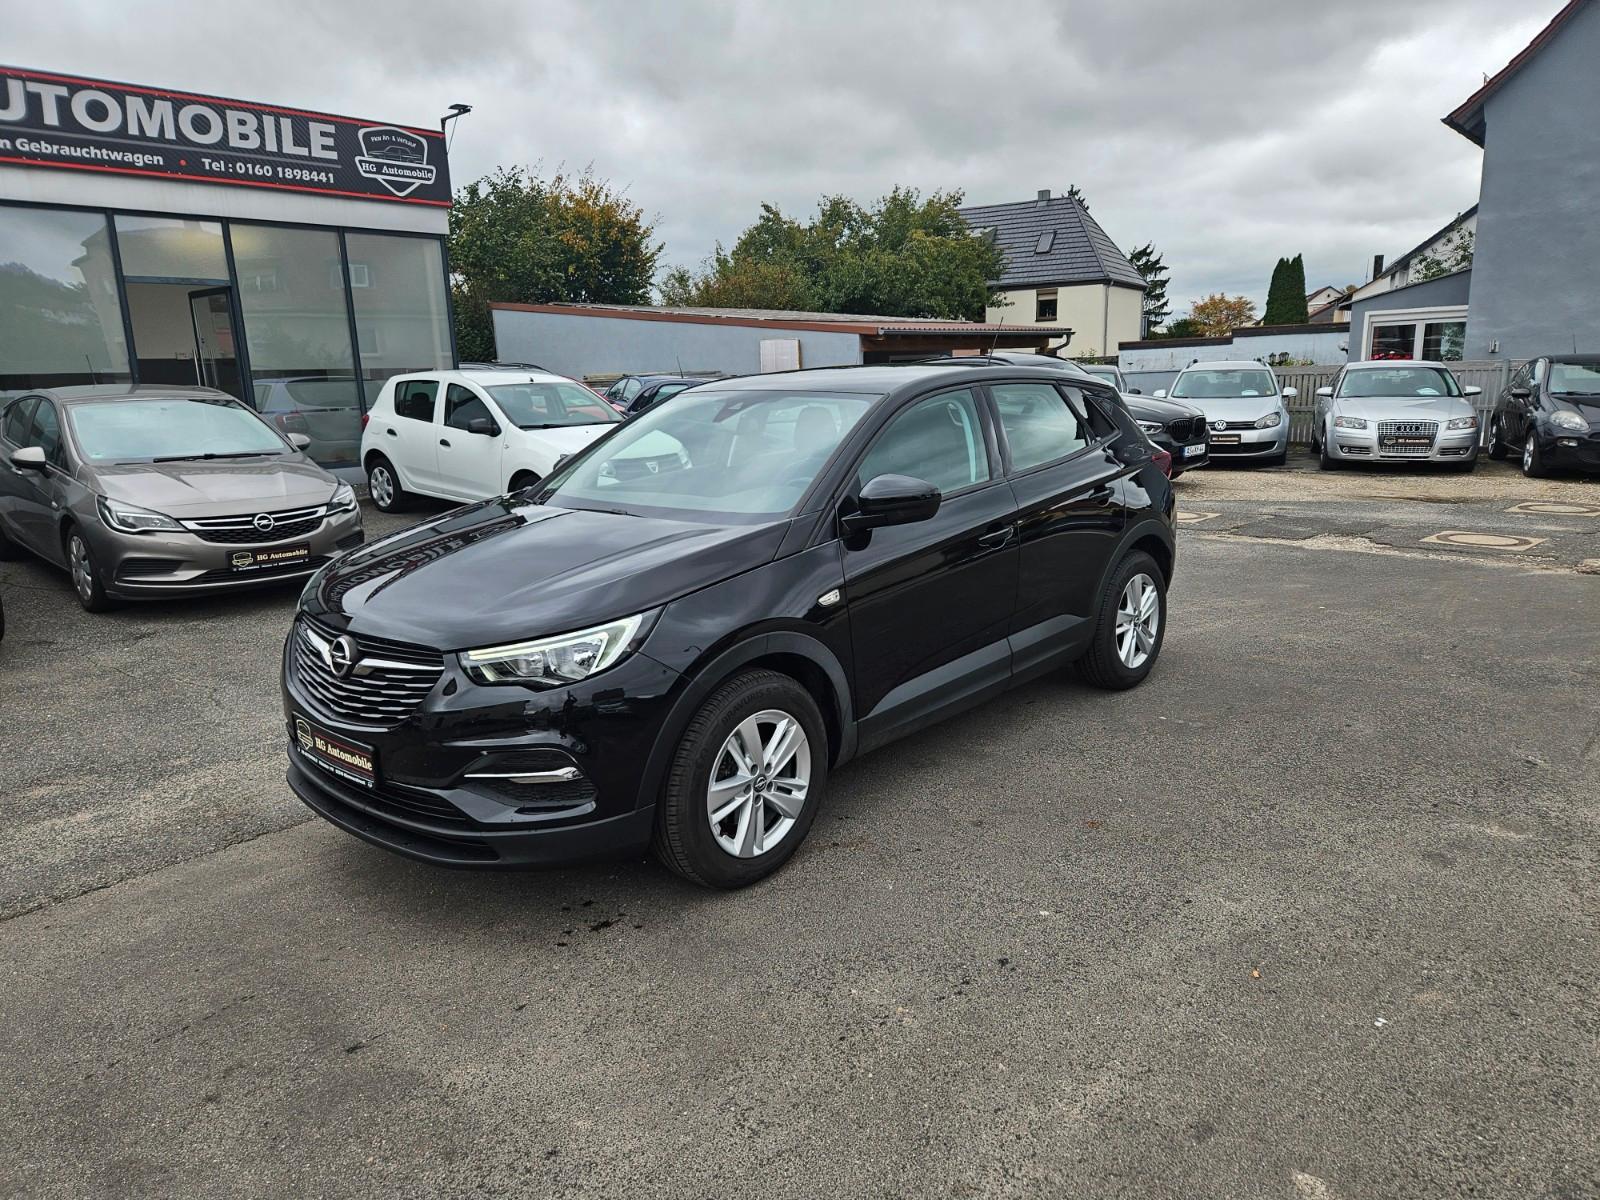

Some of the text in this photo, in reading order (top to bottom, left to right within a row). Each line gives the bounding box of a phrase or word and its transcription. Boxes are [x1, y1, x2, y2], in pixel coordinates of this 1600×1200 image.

[15, 138, 164, 166] Gebrauchtwagen
[235, 162, 272, 177] 0160
[276, 167, 334, 183] 1898441
[361, 163, 433, 179] HG Automobile
[269, 549, 308, 559] Automobile
[314, 736, 326, 751] HG
[327, 743, 373, 771] Automobile
